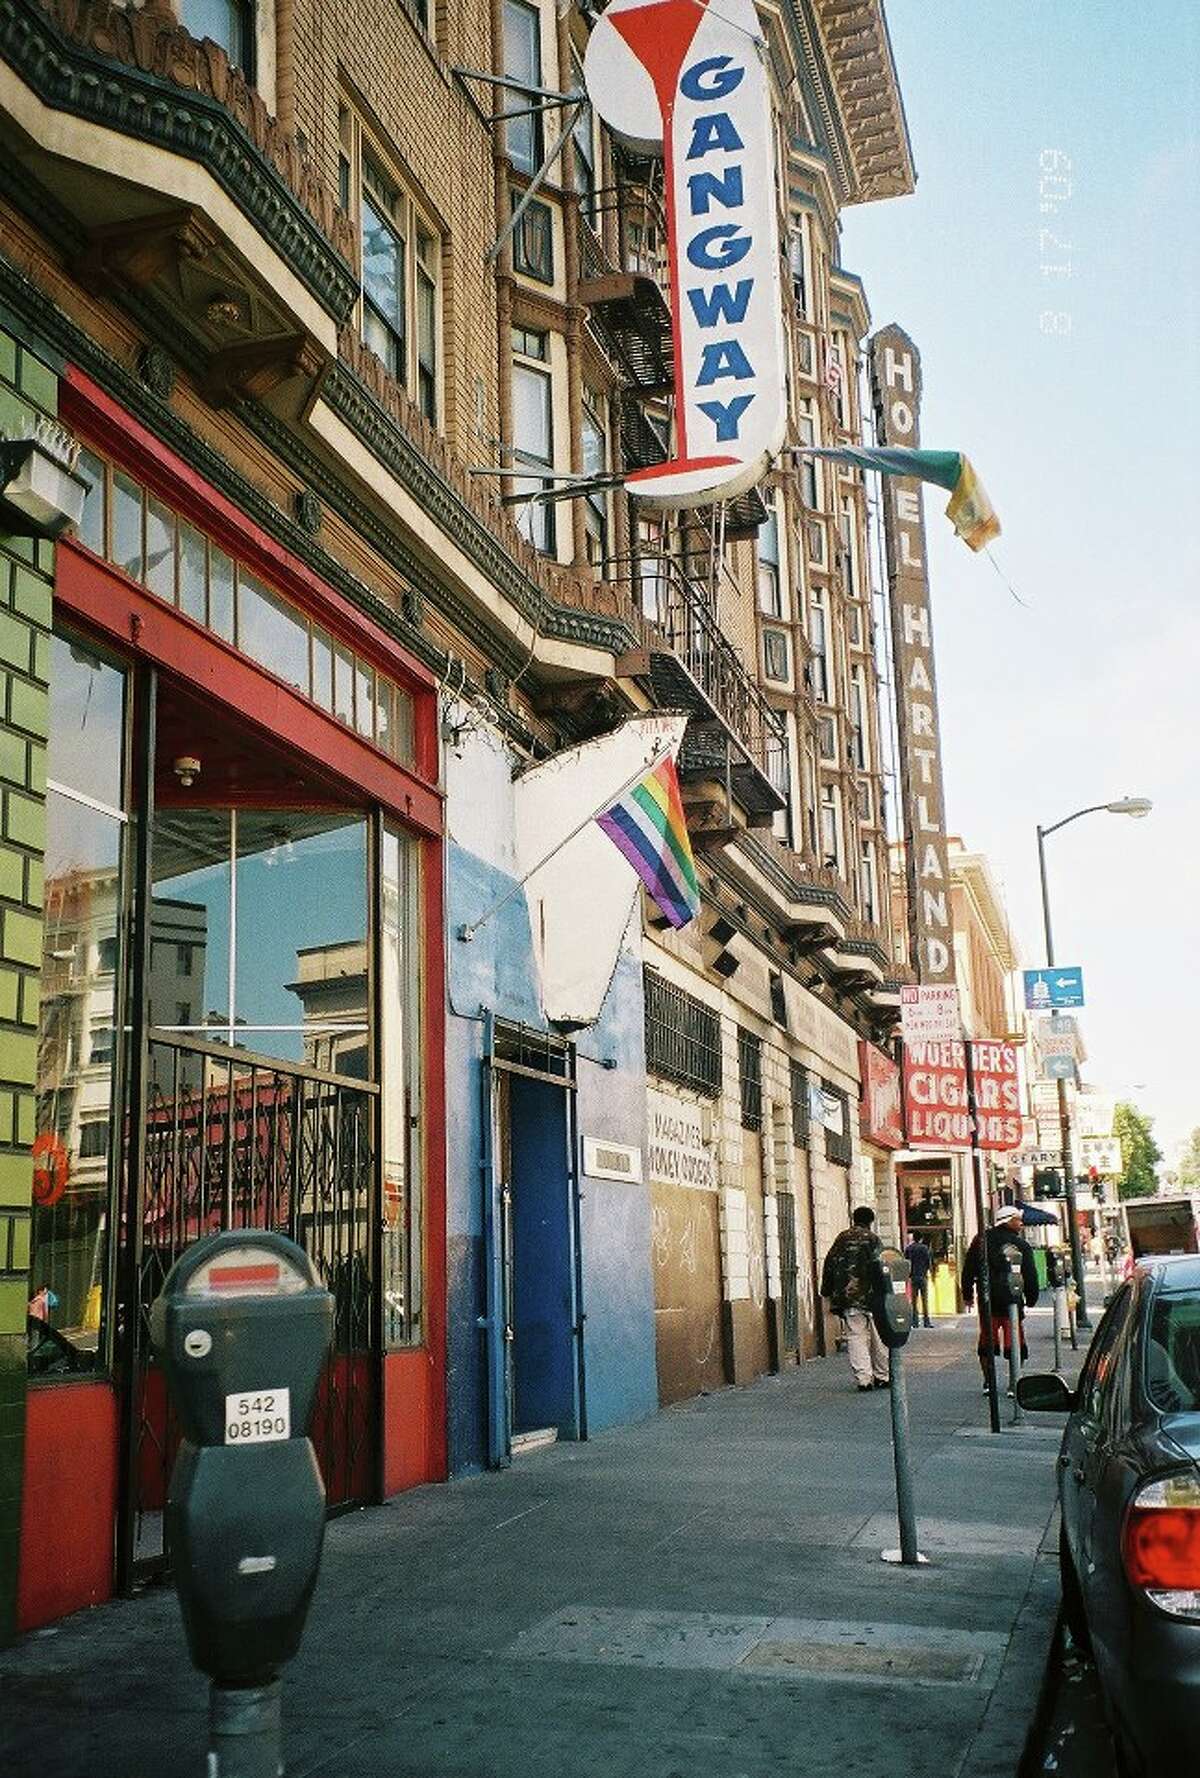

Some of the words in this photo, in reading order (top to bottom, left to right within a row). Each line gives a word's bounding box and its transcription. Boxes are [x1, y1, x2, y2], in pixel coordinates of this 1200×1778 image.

[679, 54, 757, 443] GANGWAY
[885, 347, 922, 569] HOEL
[902, 603, 951, 974] HARTLAND
[908, 1071, 1019, 1111] CIGARS
[911, 1110, 1019, 1144] LIQUORS
[1011, 1152, 1058, 1165] GEARY
[238, 1395, 275, 1416] 542
[228, 1417, 286, 1440] 08190
